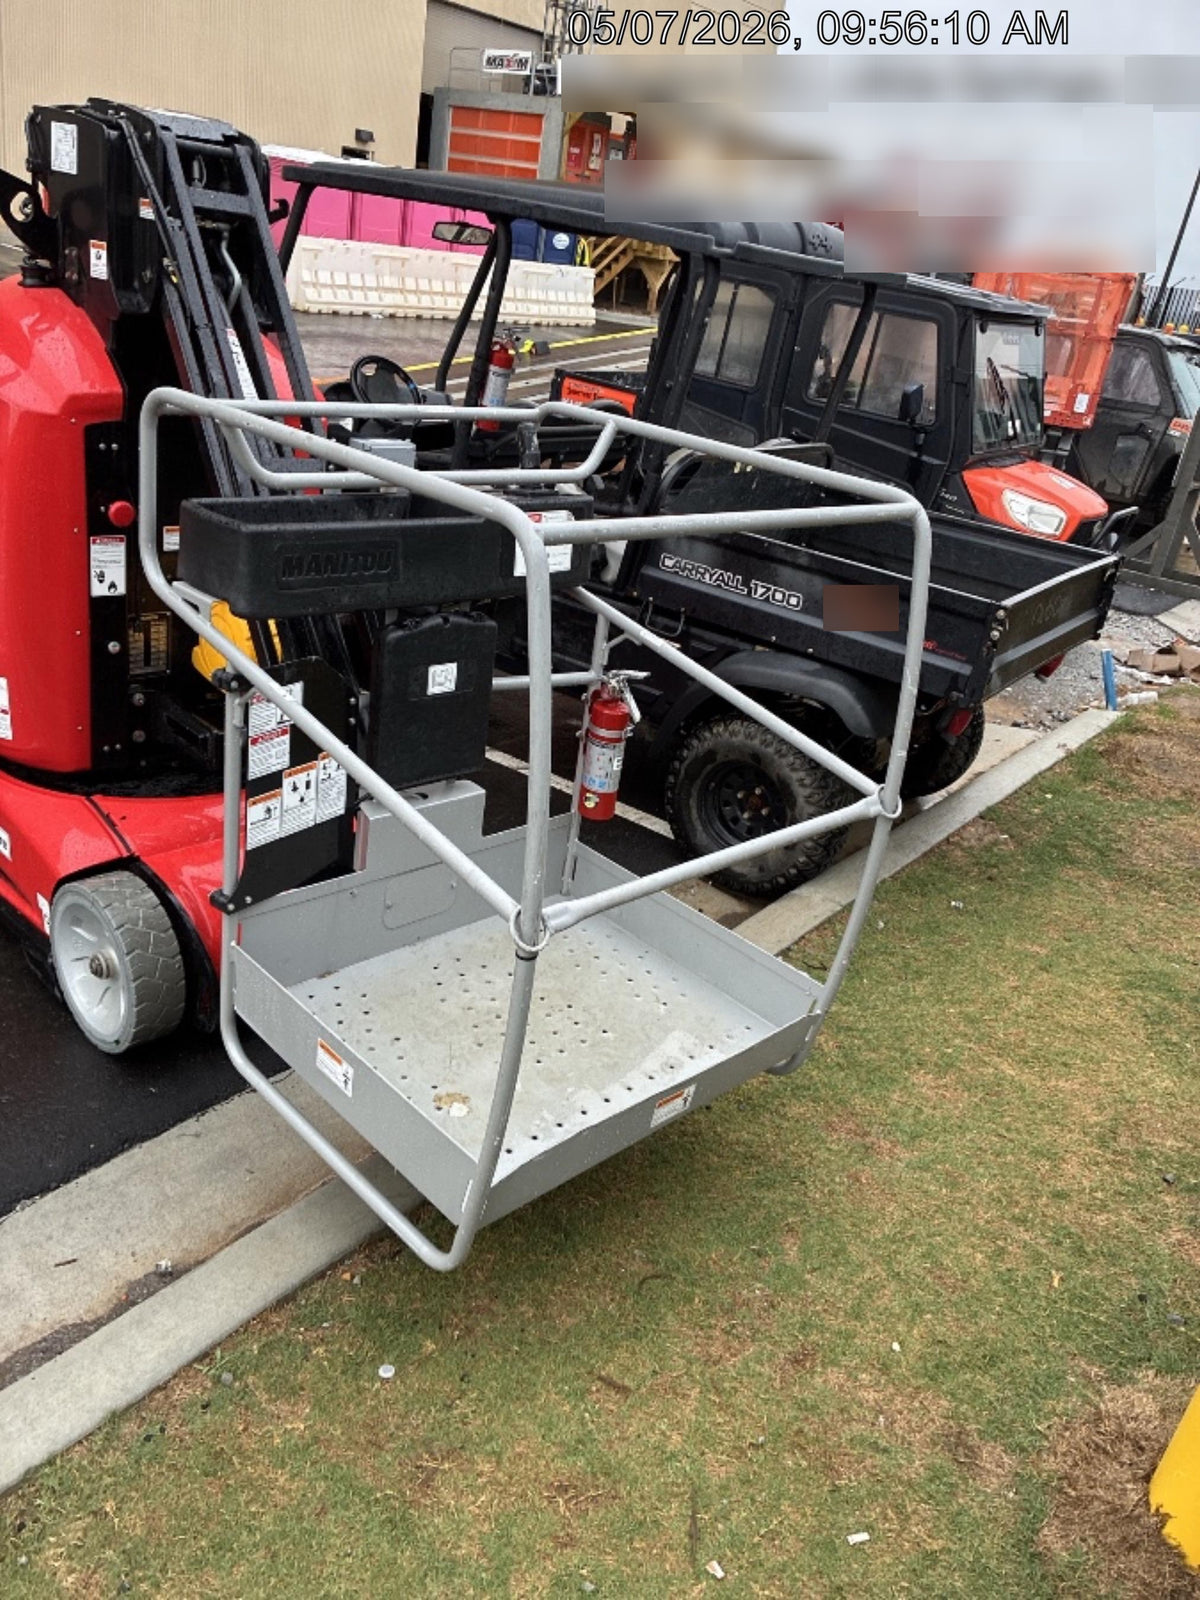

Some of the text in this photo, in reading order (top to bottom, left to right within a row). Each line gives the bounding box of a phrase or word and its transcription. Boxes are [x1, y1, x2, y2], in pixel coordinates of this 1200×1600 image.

[280, 549, 395, 581] MANITOU
[659, 552, 803, 611] CARRYALL 1700
